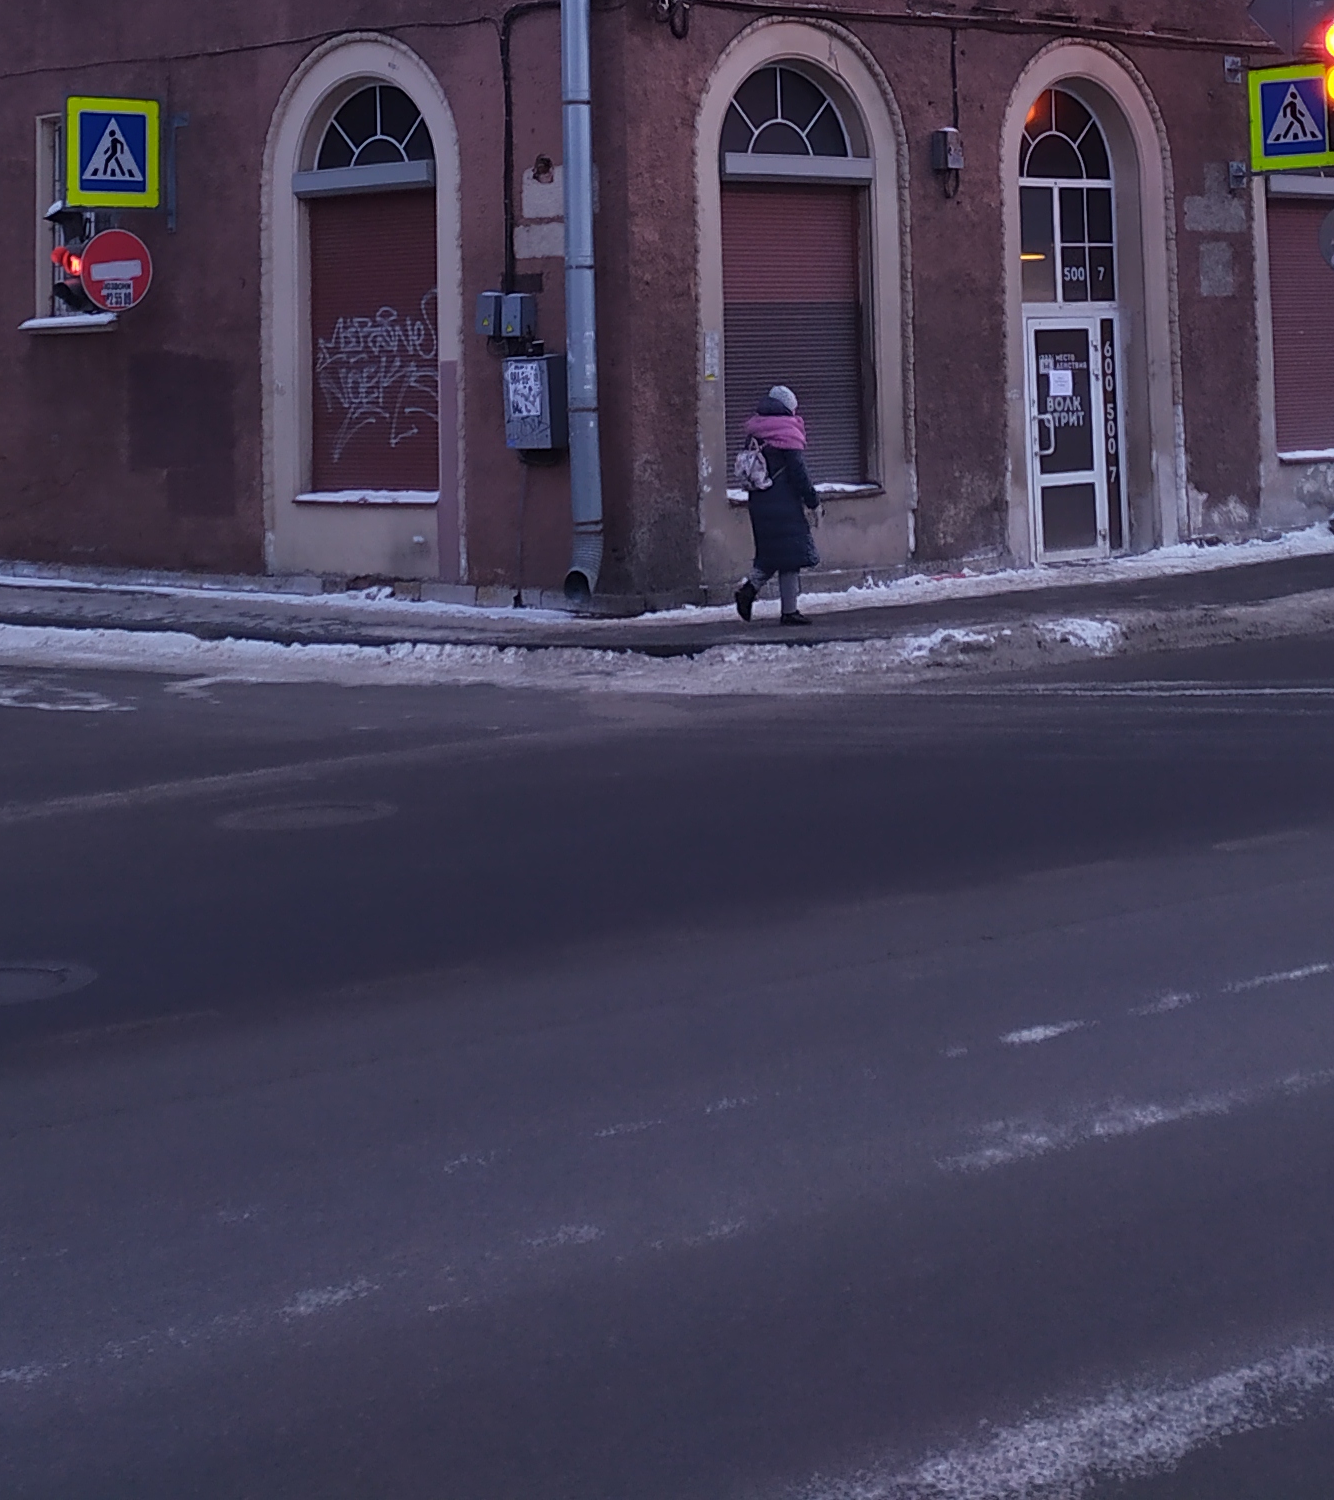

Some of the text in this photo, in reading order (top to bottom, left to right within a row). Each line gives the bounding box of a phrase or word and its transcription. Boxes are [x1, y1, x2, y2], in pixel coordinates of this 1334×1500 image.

[1063, 266, 1105, 281] 500 7
[1055, 353, 1076, 362] МЕСТО
[1046, 396, 1082, 412] ВОЛК
[1104, 341, 1117, 483] 600 500 7
